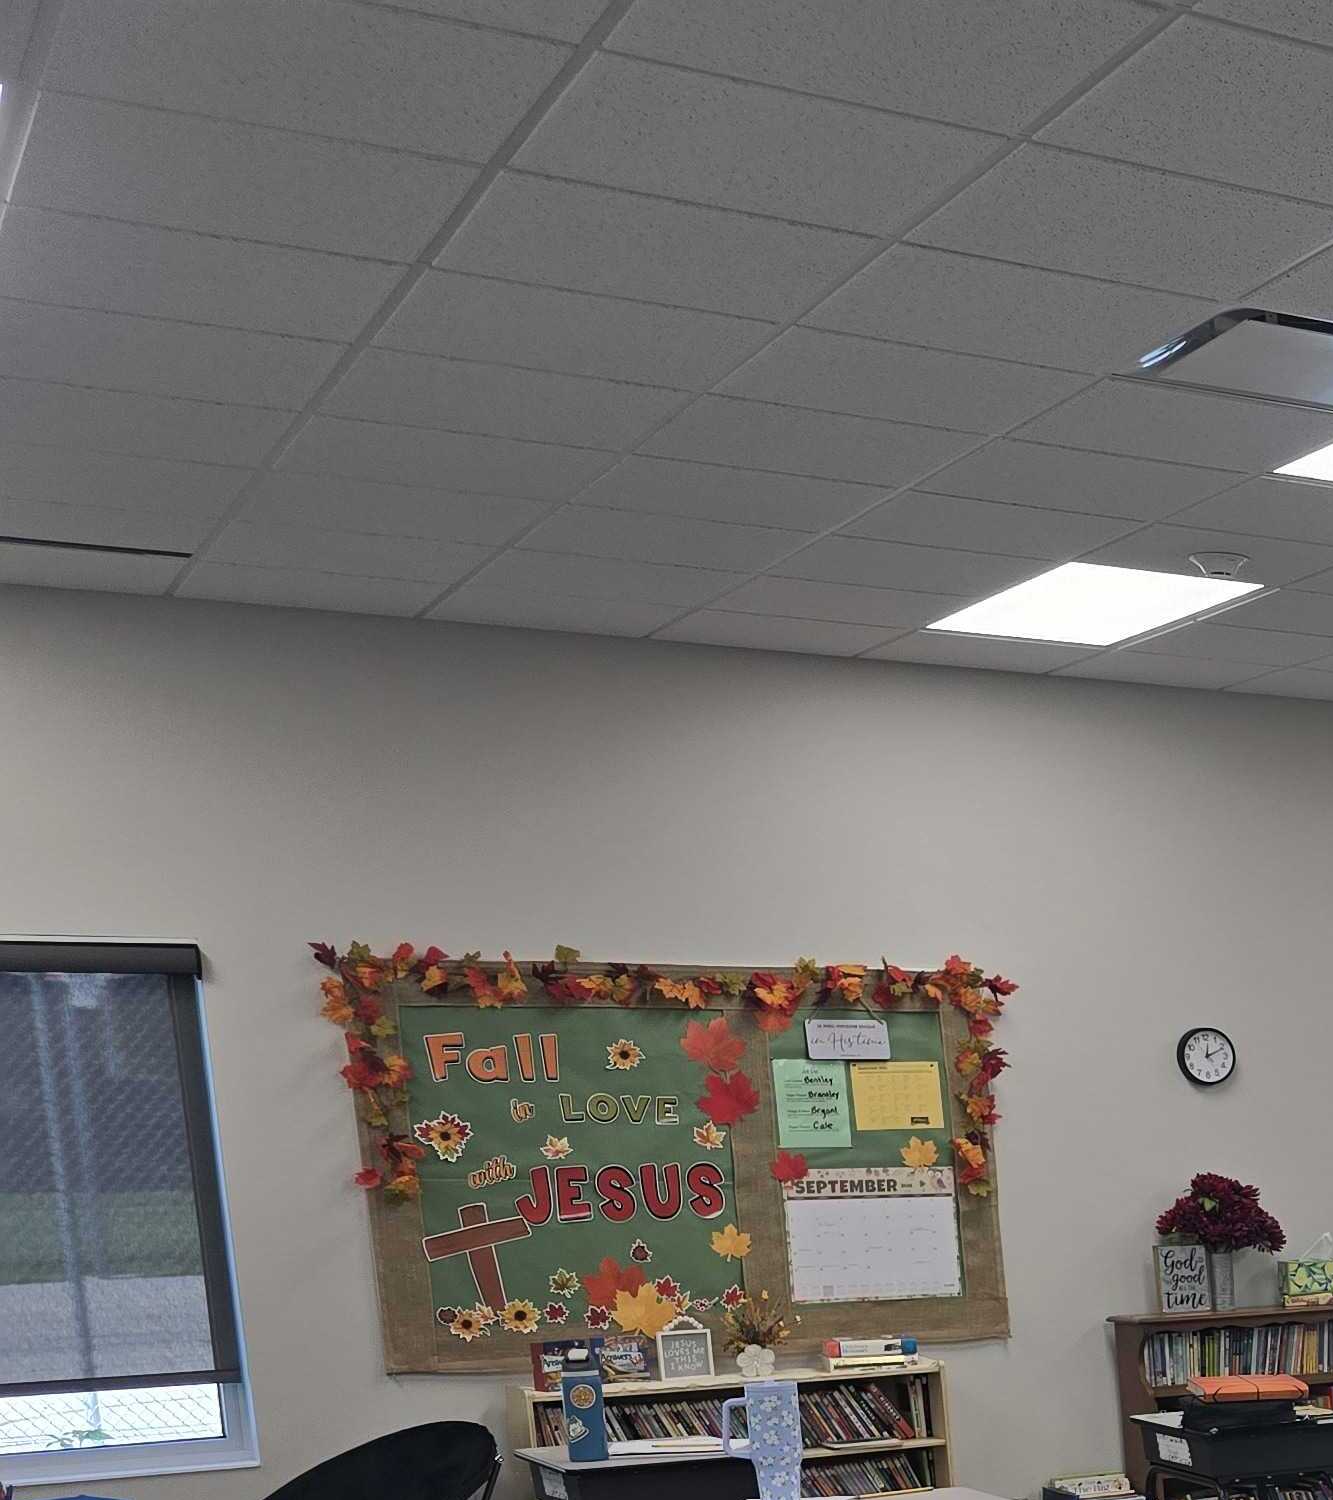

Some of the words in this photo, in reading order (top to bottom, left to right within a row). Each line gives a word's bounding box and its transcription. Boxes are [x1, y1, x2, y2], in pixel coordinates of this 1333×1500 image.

[424, 1032, 560, 1083] Fall
[510, 1098, 536, 1123] in
[558, 1092, 681, 1126] LOVE
[468, 1155, 517, 1190] with
[515, 1162, 726, 1227] JESUS
[795, 1178, 898, 1195] SEPTEMBER
[1161, 1247, 1197, 1276] God
[1170, 1265, 1206, 1291] good
[1164, 1292, 1208, 1310] time
